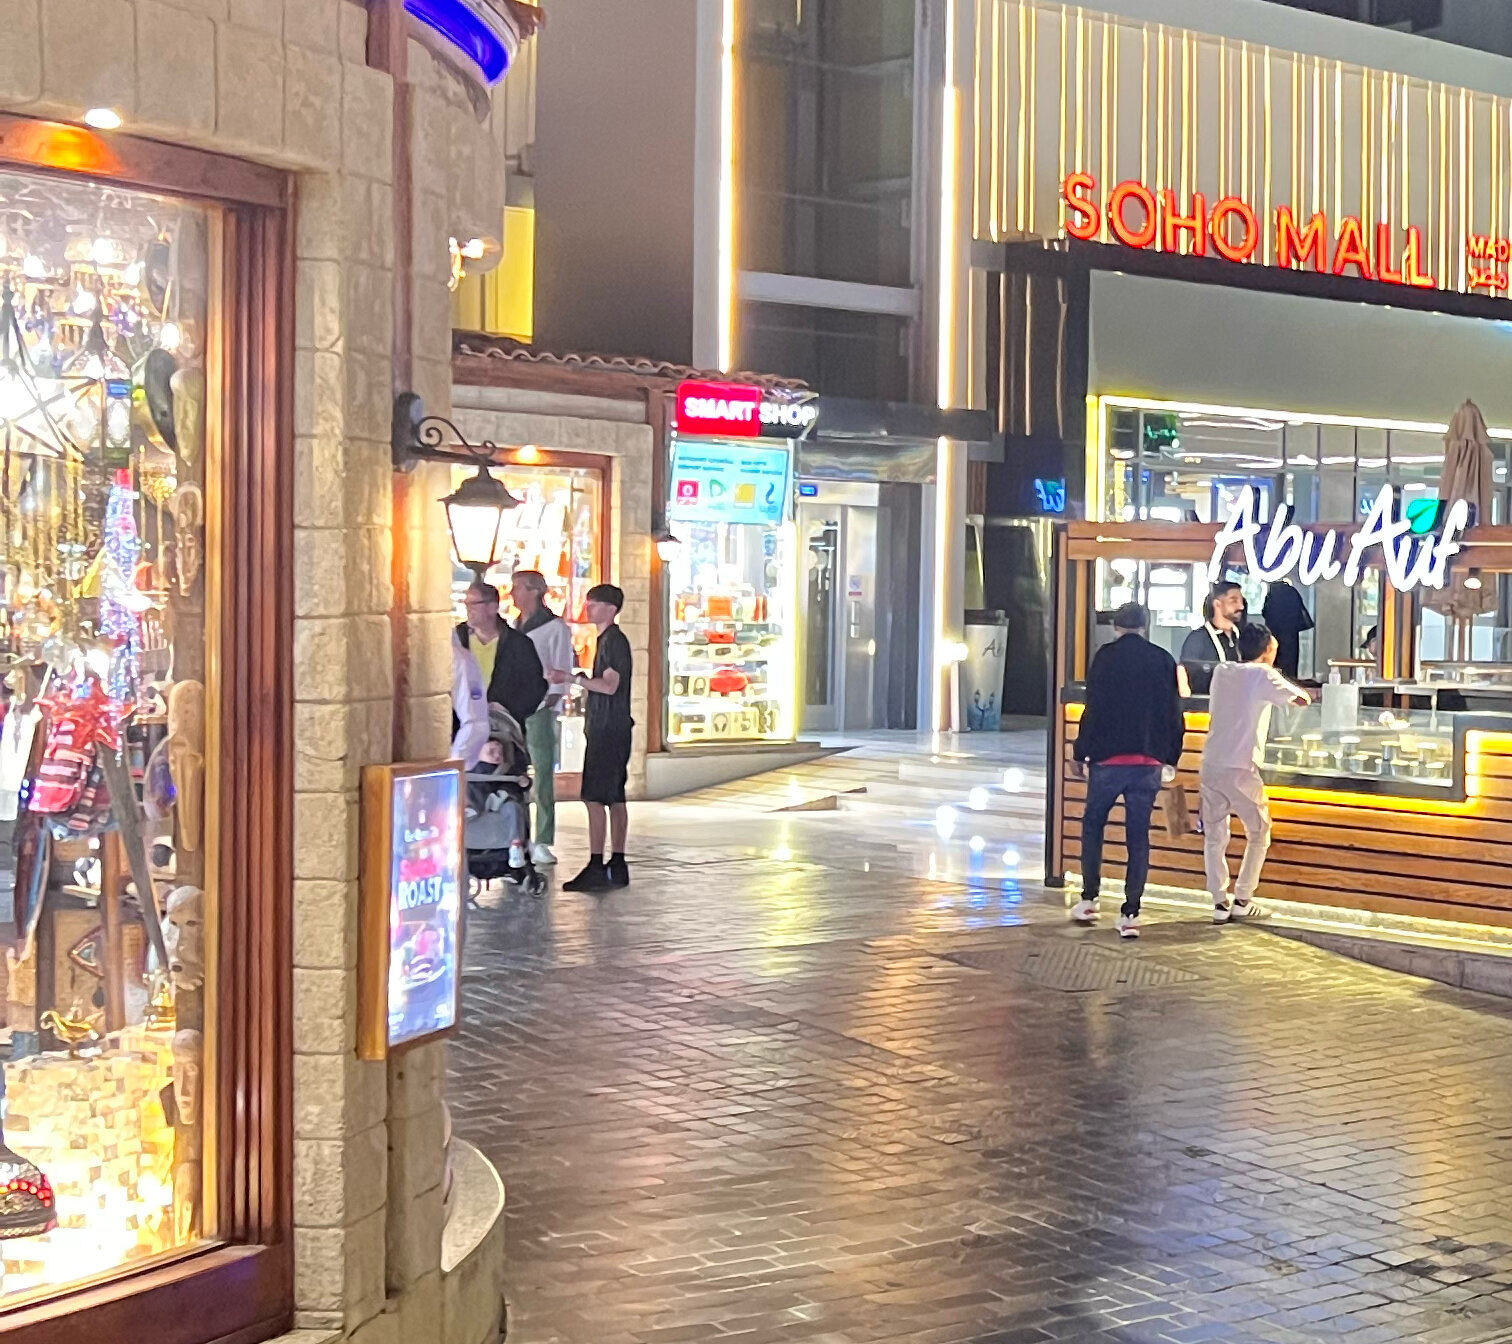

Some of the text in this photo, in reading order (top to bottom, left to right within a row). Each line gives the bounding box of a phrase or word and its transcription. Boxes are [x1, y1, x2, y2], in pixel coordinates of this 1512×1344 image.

[1064, 171, 1437, 290] SOHO MALL
[684, 396, 816, 427] SMART SHOP
[1207, 483, 1460, 593] Abu Auf
